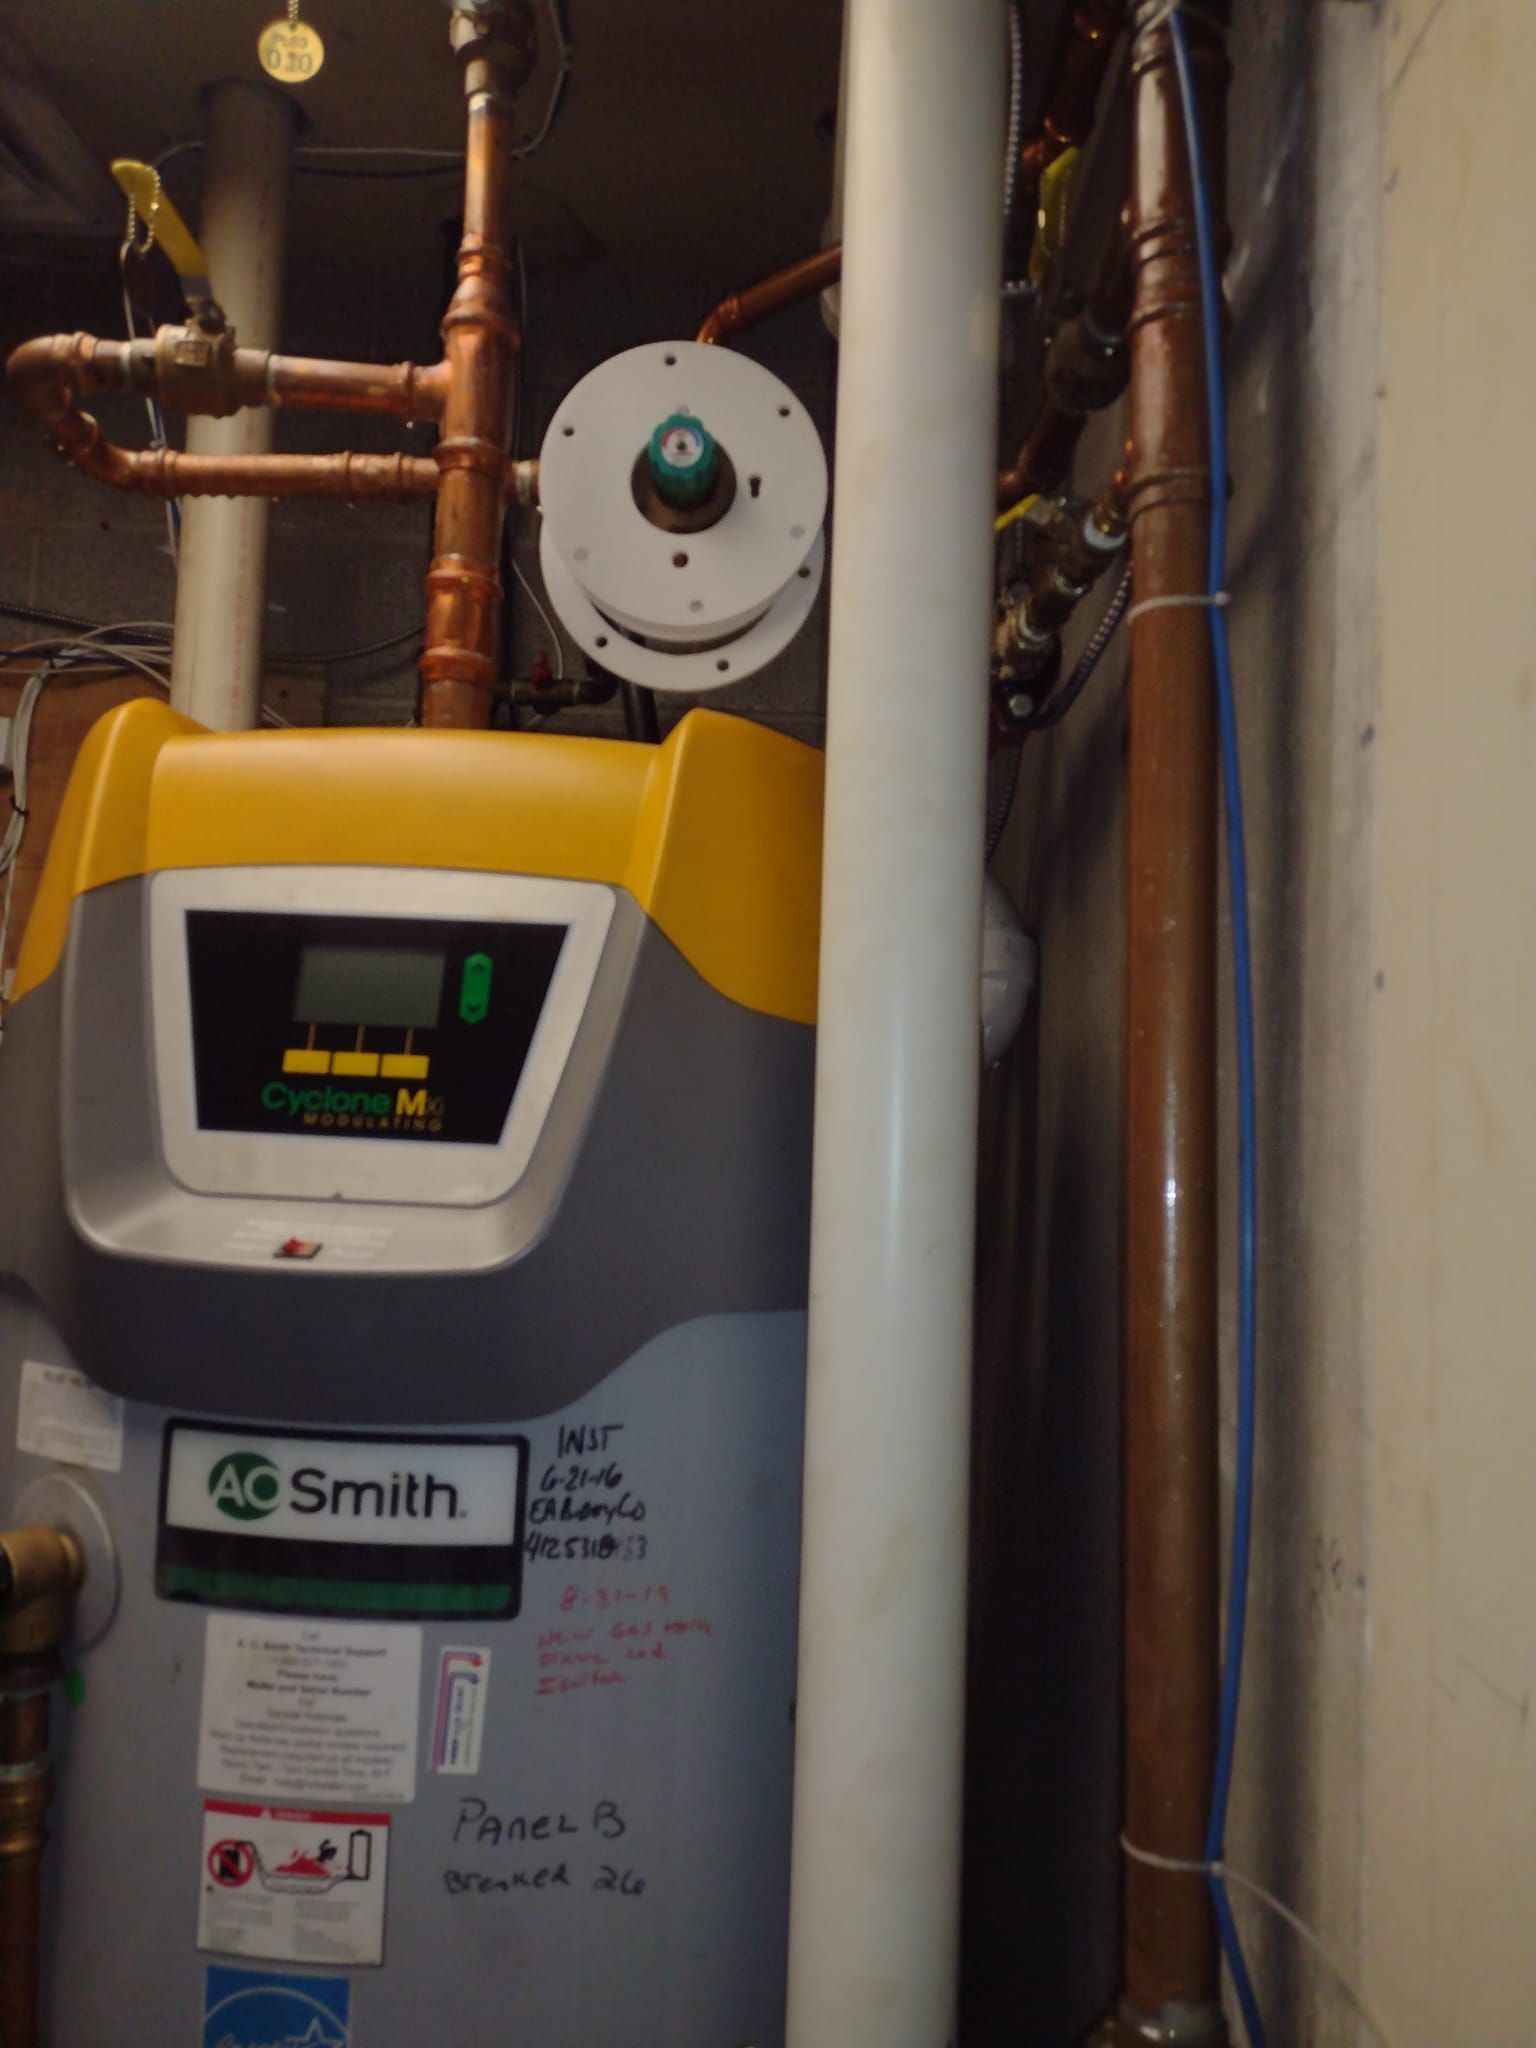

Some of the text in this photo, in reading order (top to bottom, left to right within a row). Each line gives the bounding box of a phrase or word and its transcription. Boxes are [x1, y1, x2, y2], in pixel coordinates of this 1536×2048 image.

[261, 1081, 391, 1116] Cyclone
[303, 1113, 444, 1133] MODULATING
[557, 1424, 624, 1457] INST
[209, 1458, 458, 1519] AO Smith
[593, 1801, 625, 1839] B
